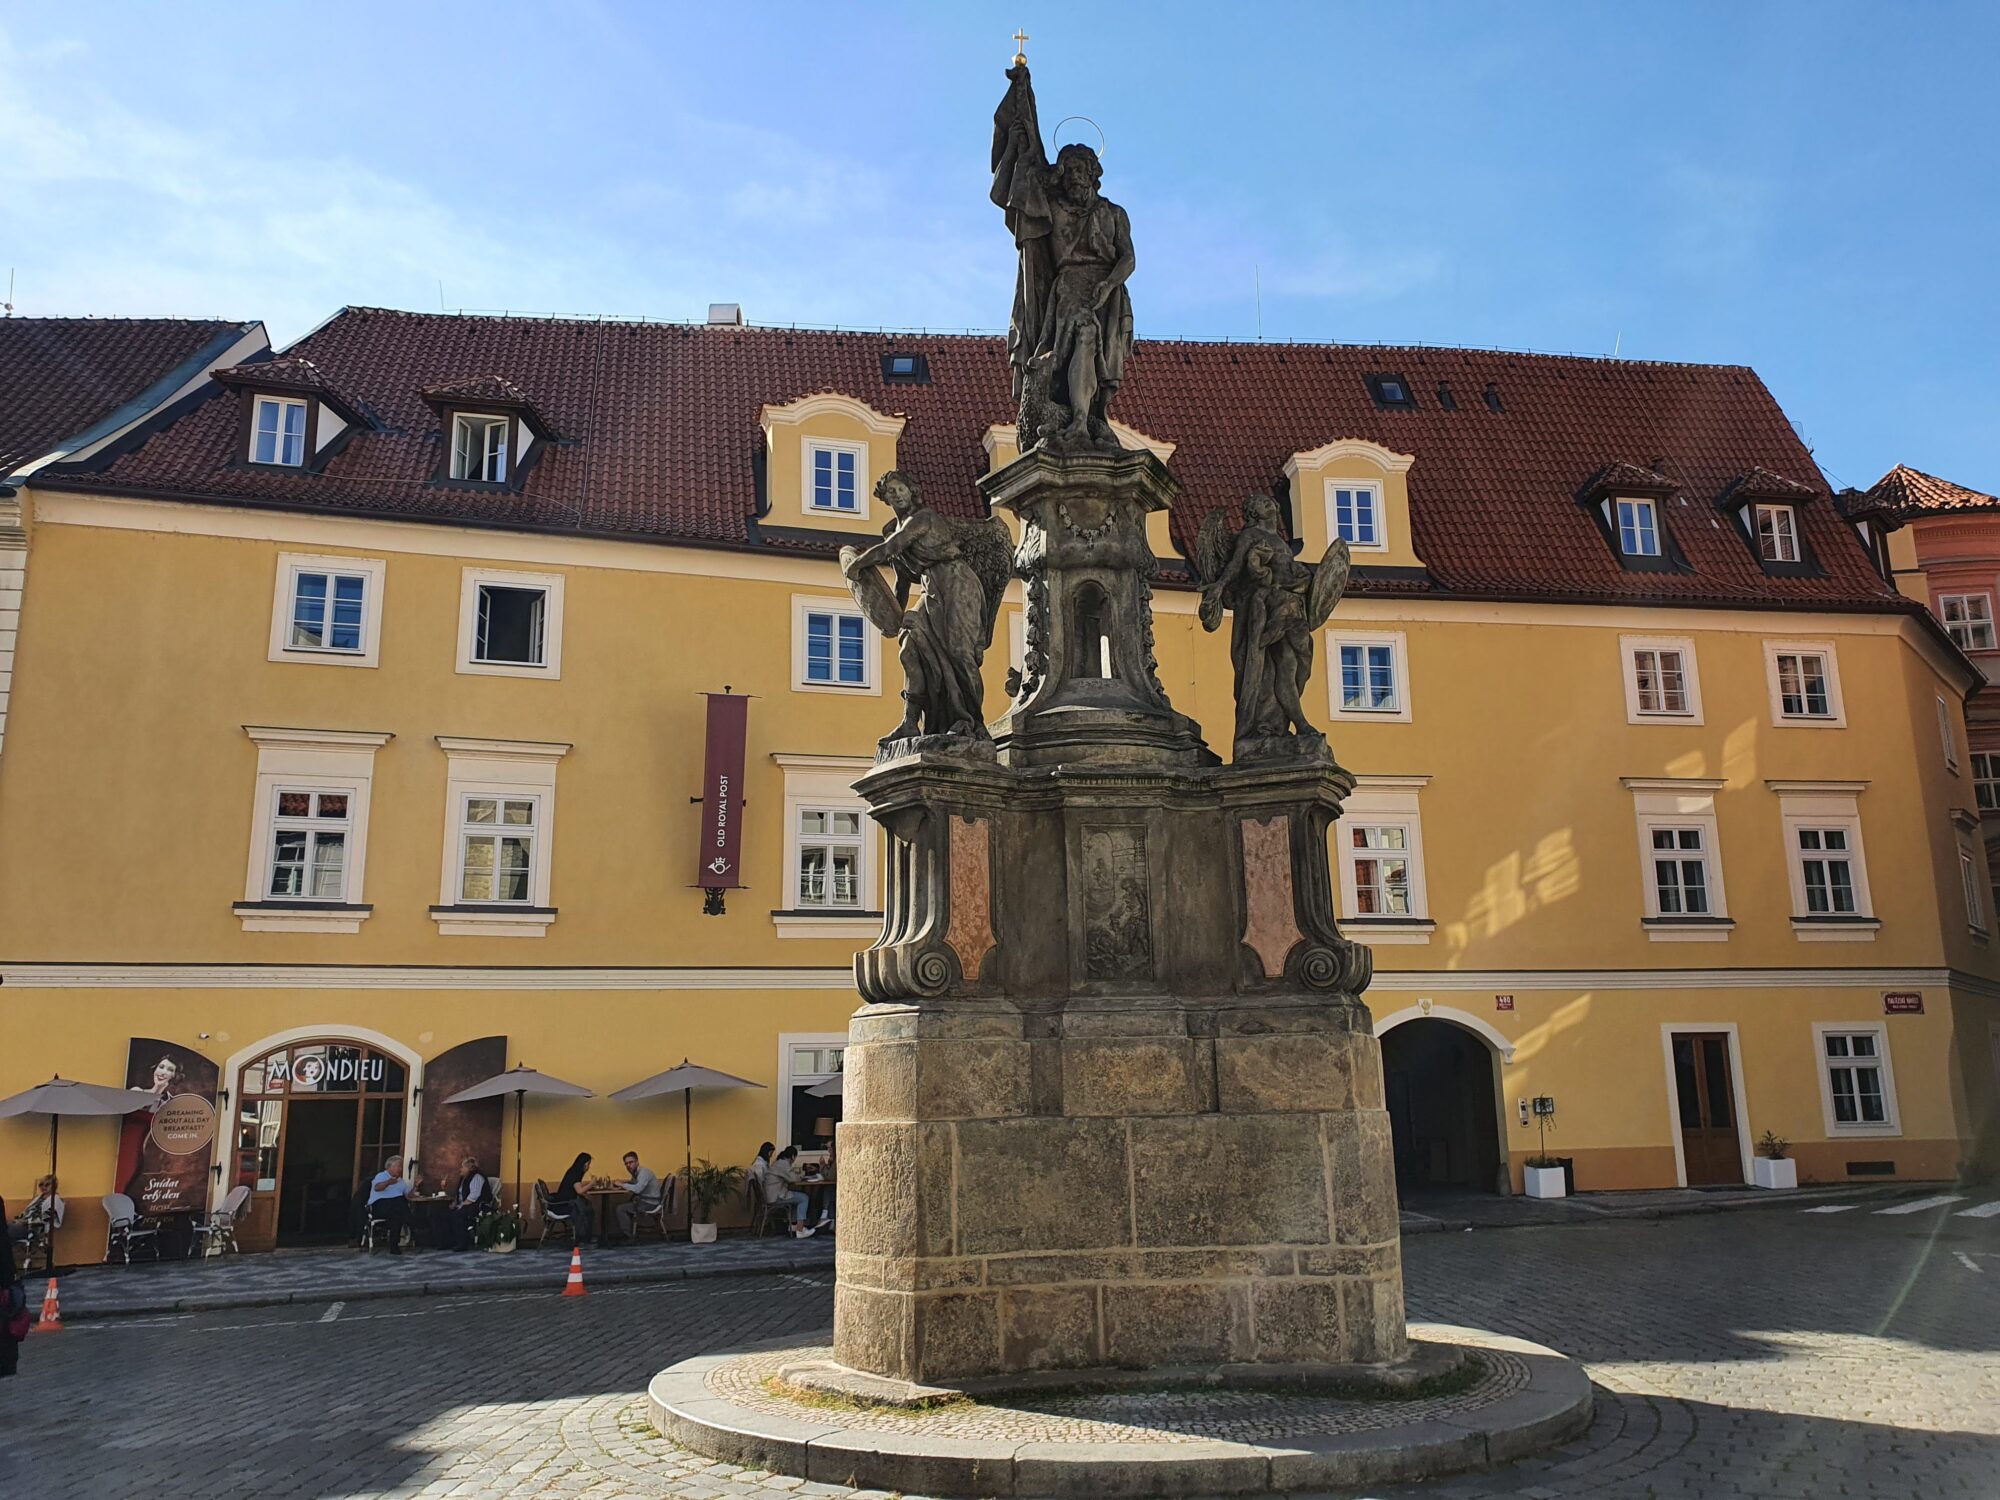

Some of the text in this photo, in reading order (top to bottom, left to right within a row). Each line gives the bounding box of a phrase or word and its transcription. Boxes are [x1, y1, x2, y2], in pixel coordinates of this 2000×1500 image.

[717, 775, 729, 848] OLD ROYAL POST
[162, 1189, 180, 1200] den
